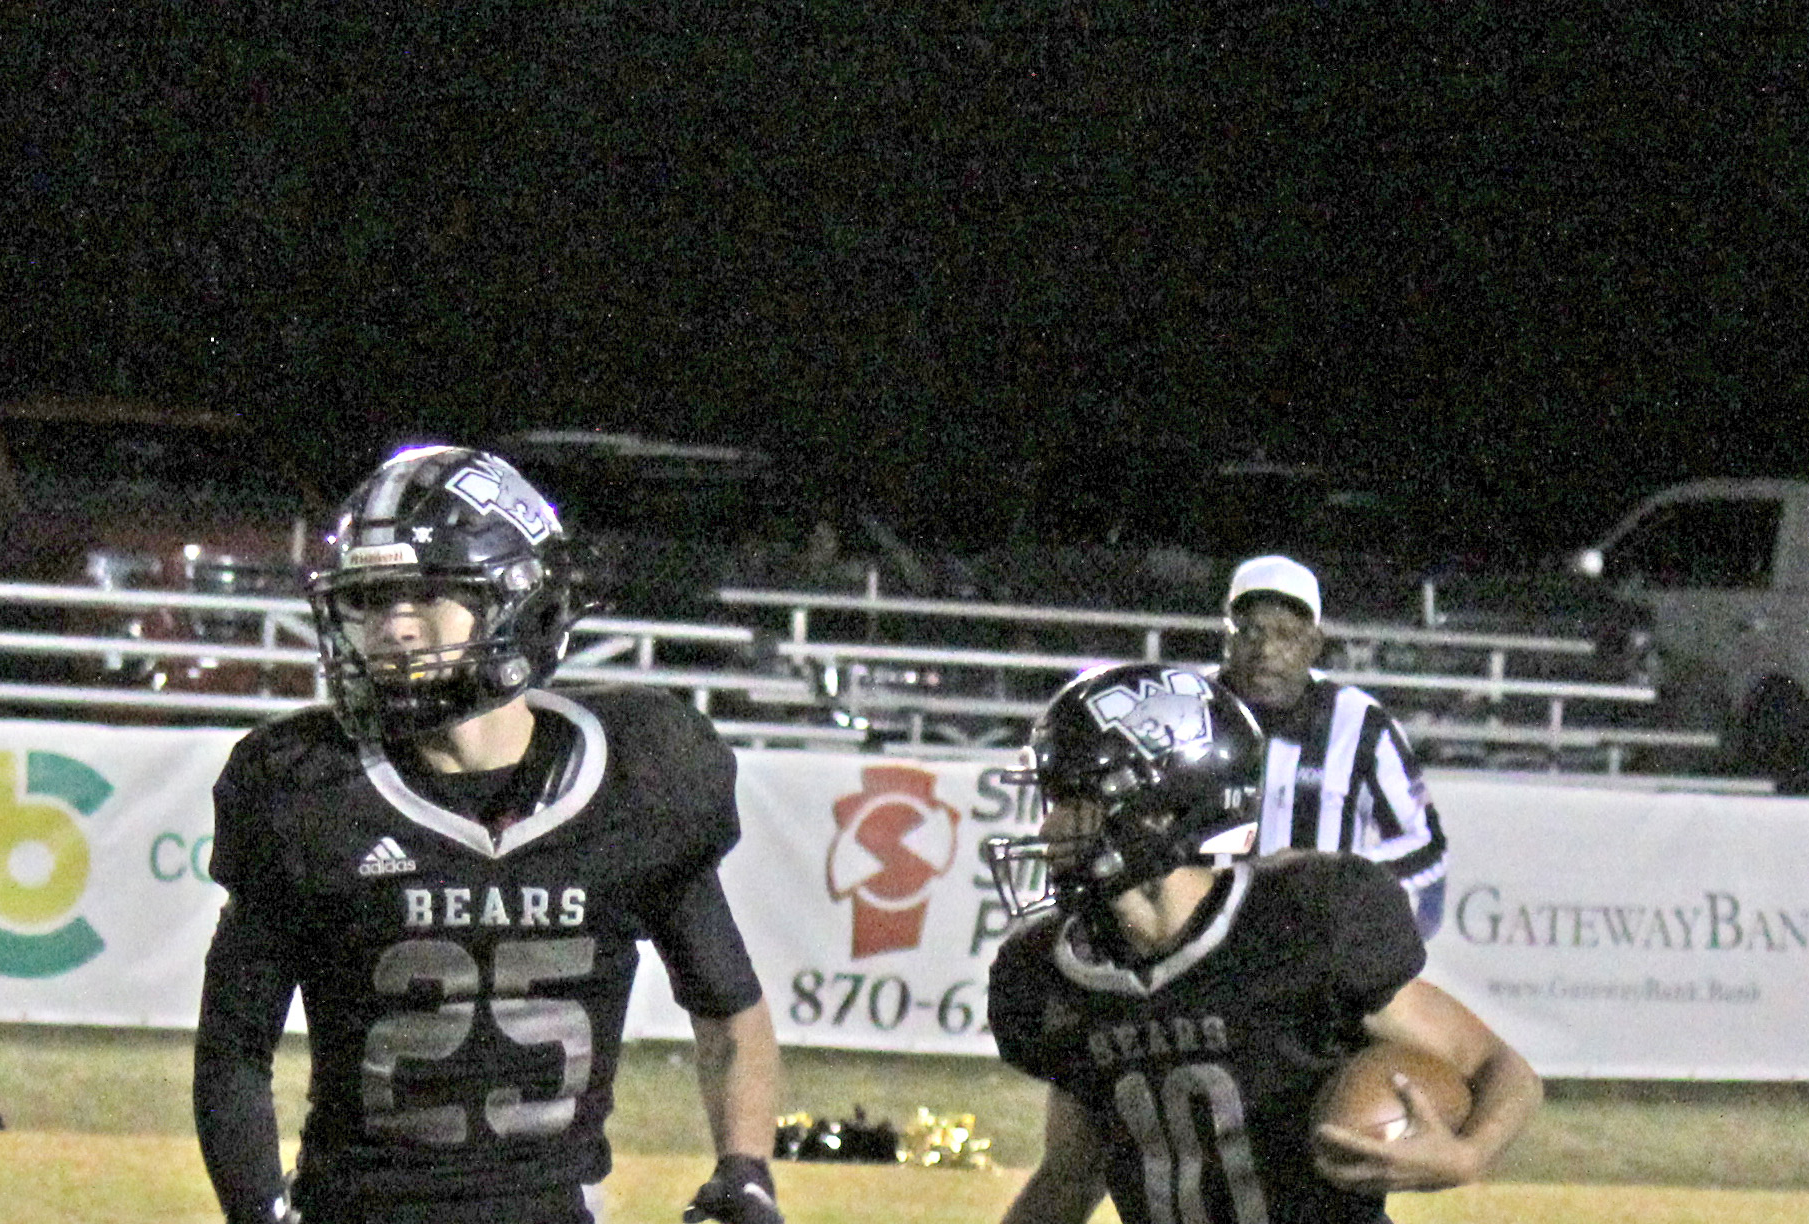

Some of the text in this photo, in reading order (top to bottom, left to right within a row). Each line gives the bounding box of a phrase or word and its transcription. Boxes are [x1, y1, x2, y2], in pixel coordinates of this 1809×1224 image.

[359, 859, 416, 876] adidas
[404, 887, 587, 926] BEARS
[362, 937, 595, 1144] 25
